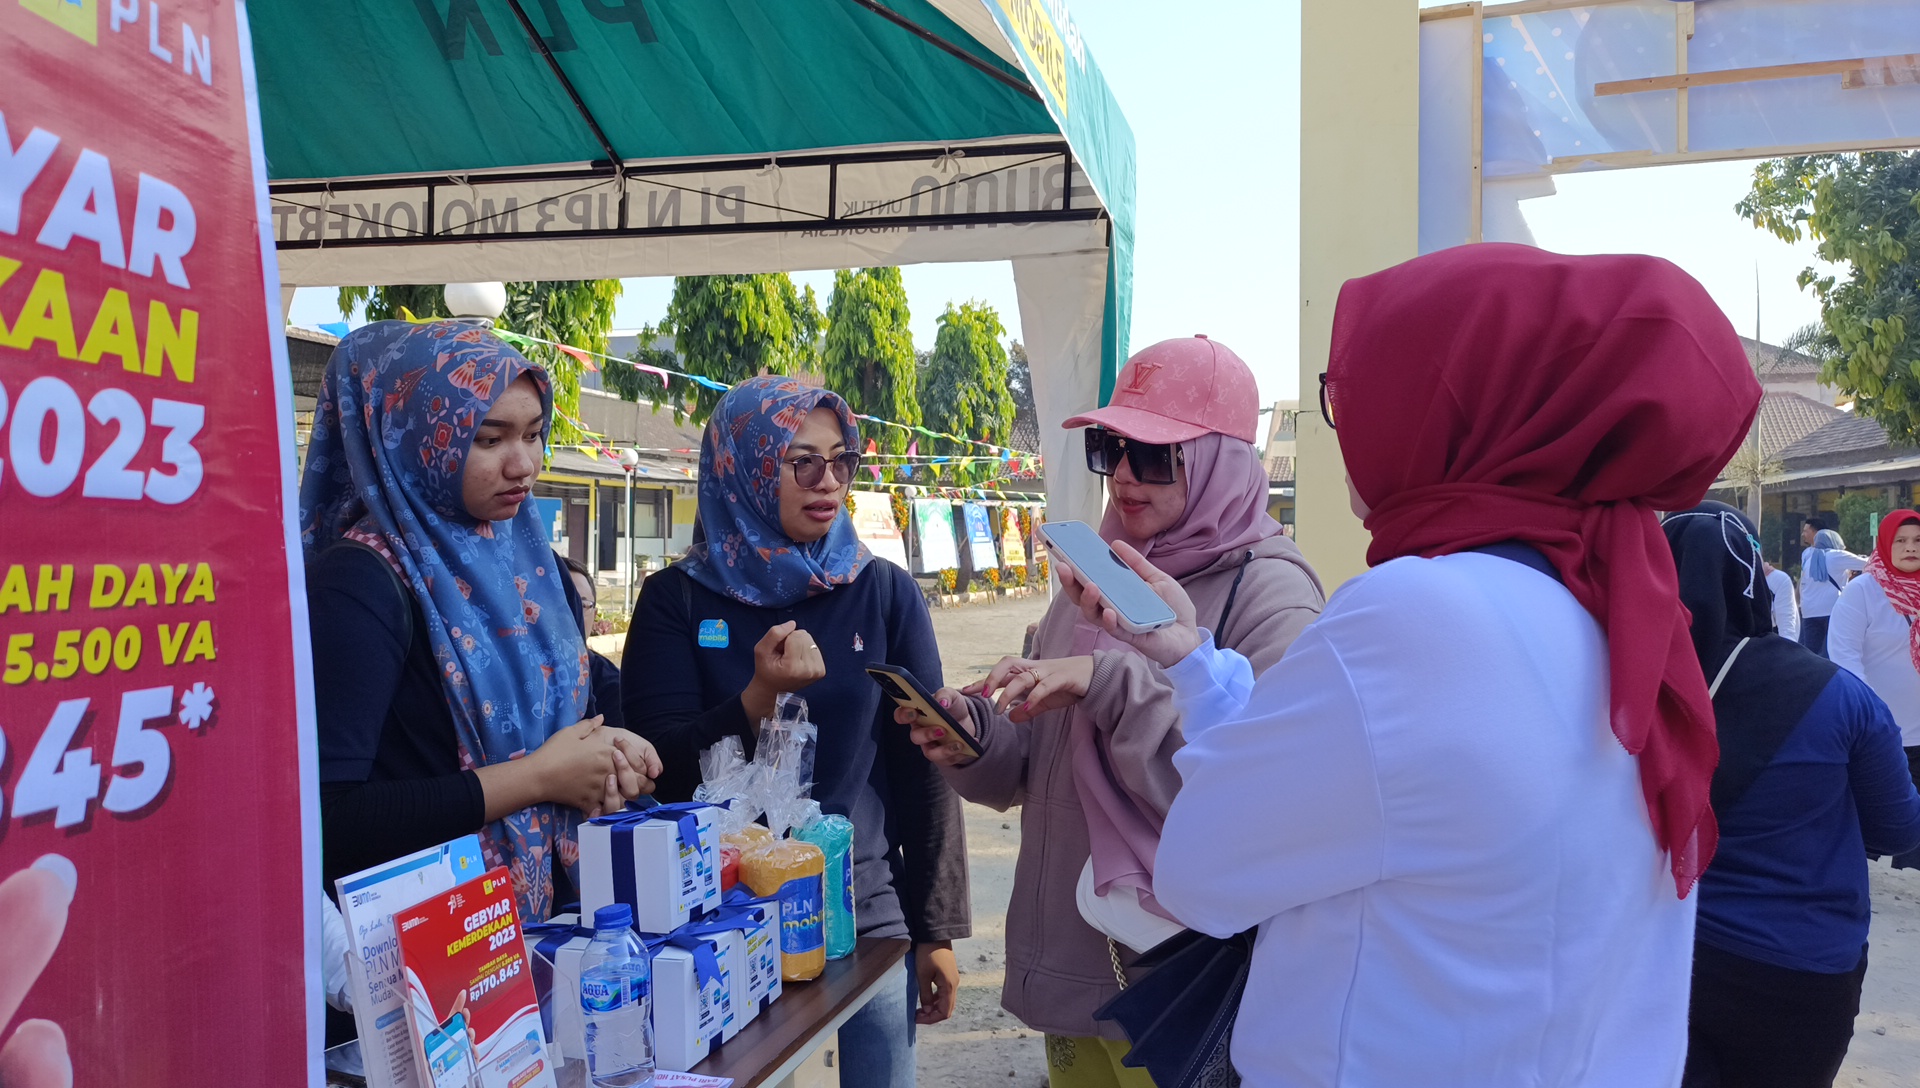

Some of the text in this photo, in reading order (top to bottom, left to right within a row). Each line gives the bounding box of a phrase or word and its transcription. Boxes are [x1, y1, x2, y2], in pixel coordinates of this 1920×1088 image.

[110, 0, 213, 86] PLN
[1046, 0, 1086, 77] udah
[0, 108, 197, 290] YAR
[0, 374, 205, 505] 023
[0, 562, 216, 613] AH DAYA
[2, 620, 217, 685] 5.500 VA
[0, 682, 216, 830] 45
[492, 876, 507, 888] PLN
[464, 898, 511, 933] GEBYAR
[782, 899, 813, 917] PLN
[447, 912, 514, 957] KEMERDEKAAN
[489, 924, 516, 951] 2023
[582, 982, 610, 999] AQUA
